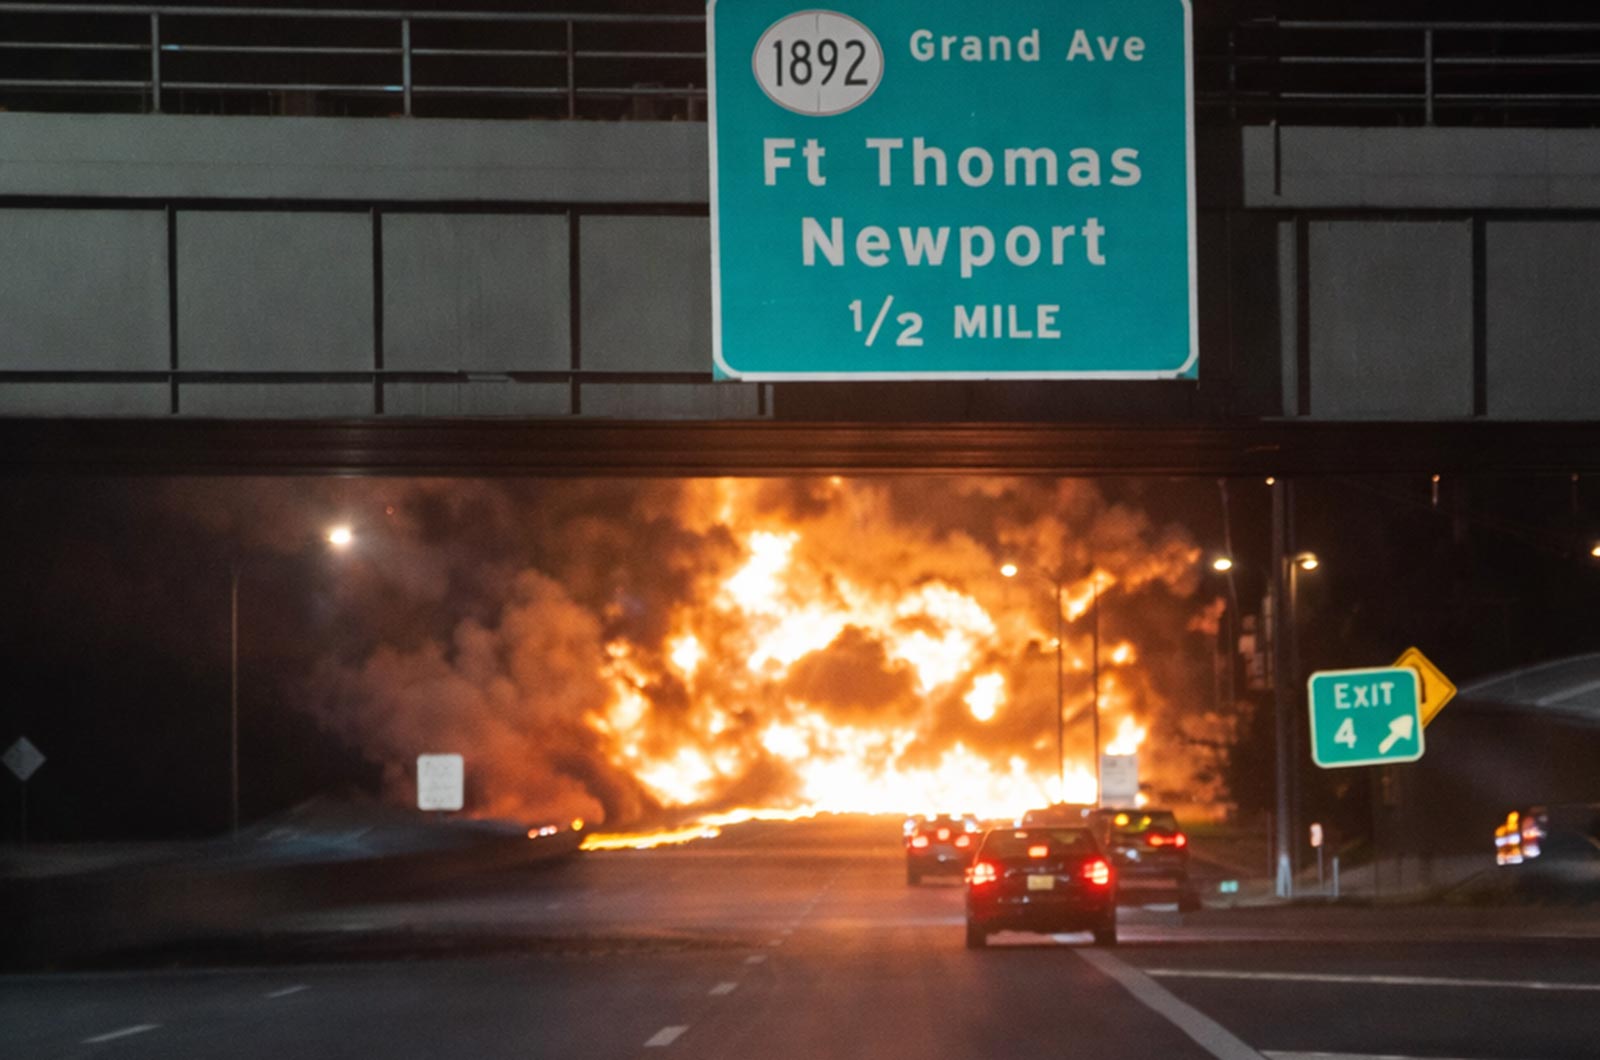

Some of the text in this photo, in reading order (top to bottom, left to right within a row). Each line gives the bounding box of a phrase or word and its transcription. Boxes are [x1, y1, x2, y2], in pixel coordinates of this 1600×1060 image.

[773, 39, 868, 87] 1892
[909, 29, 1147, 62] Grand Ave
[763, 137, 1142, 188] Ft Thomas
[801, 217, 1106, 279] Newport
[849, 295, 1061, 347] 1/2 MILE
[1334, 681, 1395, 710] EXIT
[1334, 717, 1358, 749] 4
